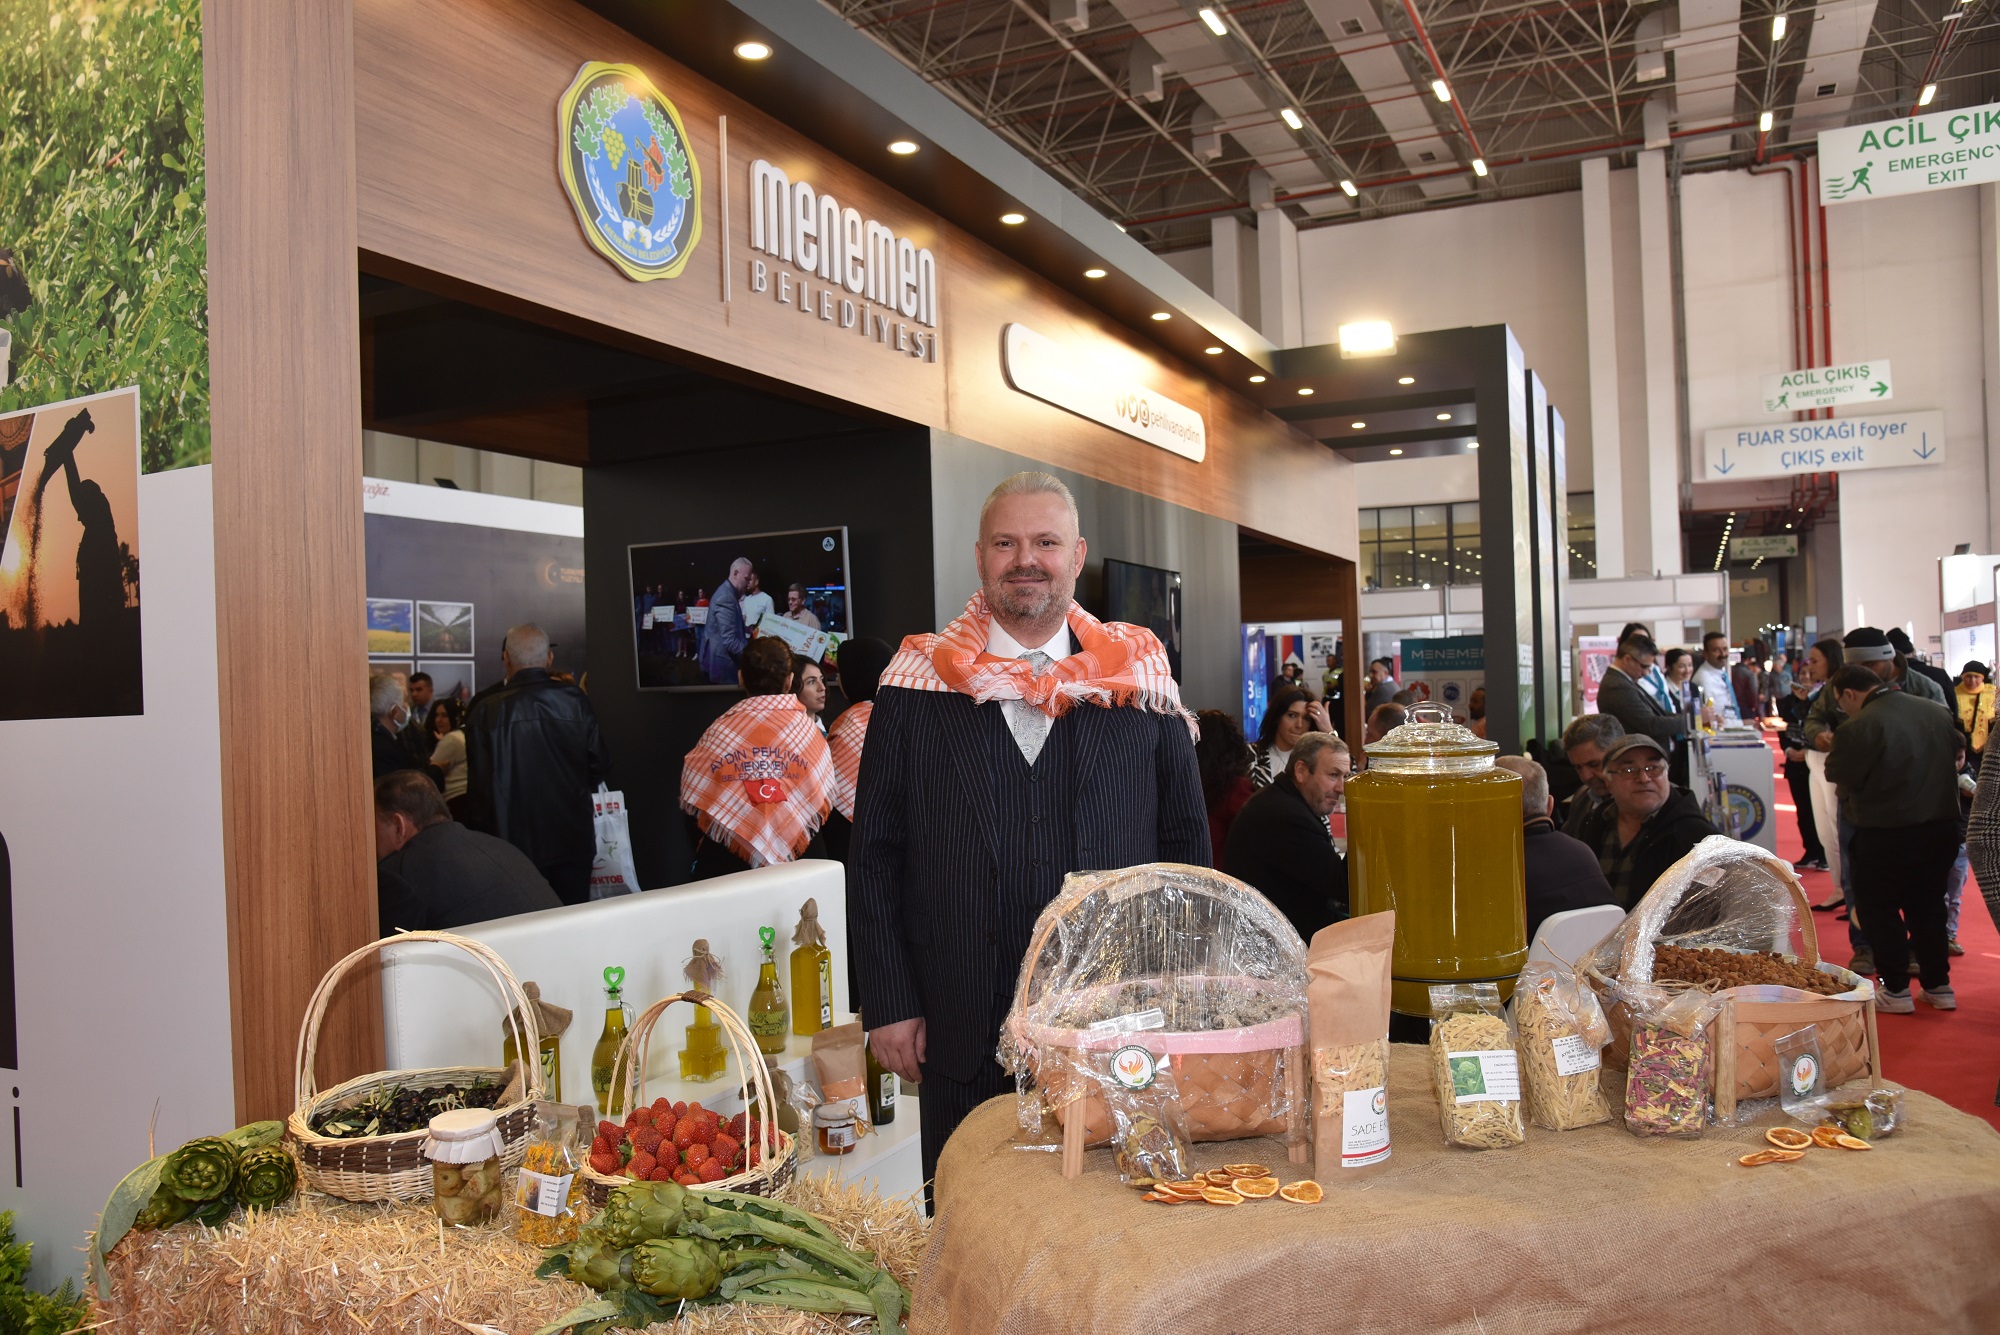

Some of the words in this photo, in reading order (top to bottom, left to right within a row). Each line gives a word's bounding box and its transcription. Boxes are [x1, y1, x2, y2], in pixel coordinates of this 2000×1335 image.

[1858, 118, 1937, 153] ACİL
[1928, 167, 1968, 185] EXIT
[1781, 371, 1819, 387] ACİL
[1825, 365, 1870, 385] ÇIKIŞ
[1796, 384, 1855, 399] EMERGENCY
[1816, 396, 1836, 406] EXIT
[1737, 429, 1785, 447] FUAR
[1789, 421, 1855, 443] SOKAĞI
[1860, 422, 1907, 440] foyer
[1781, 449, 1825, 469] ÇIKIŞ
[1831, 446, 1864, 463] exit
[710, 749, 747, 773] AYDIN
[752, 746, 809, 770] PEHLİVAN
[734, 760, 789, 772] MENEMEN
[590, 874, 625, 885] RKTOB
[1351, 1121, 1377, 1137] SADE
